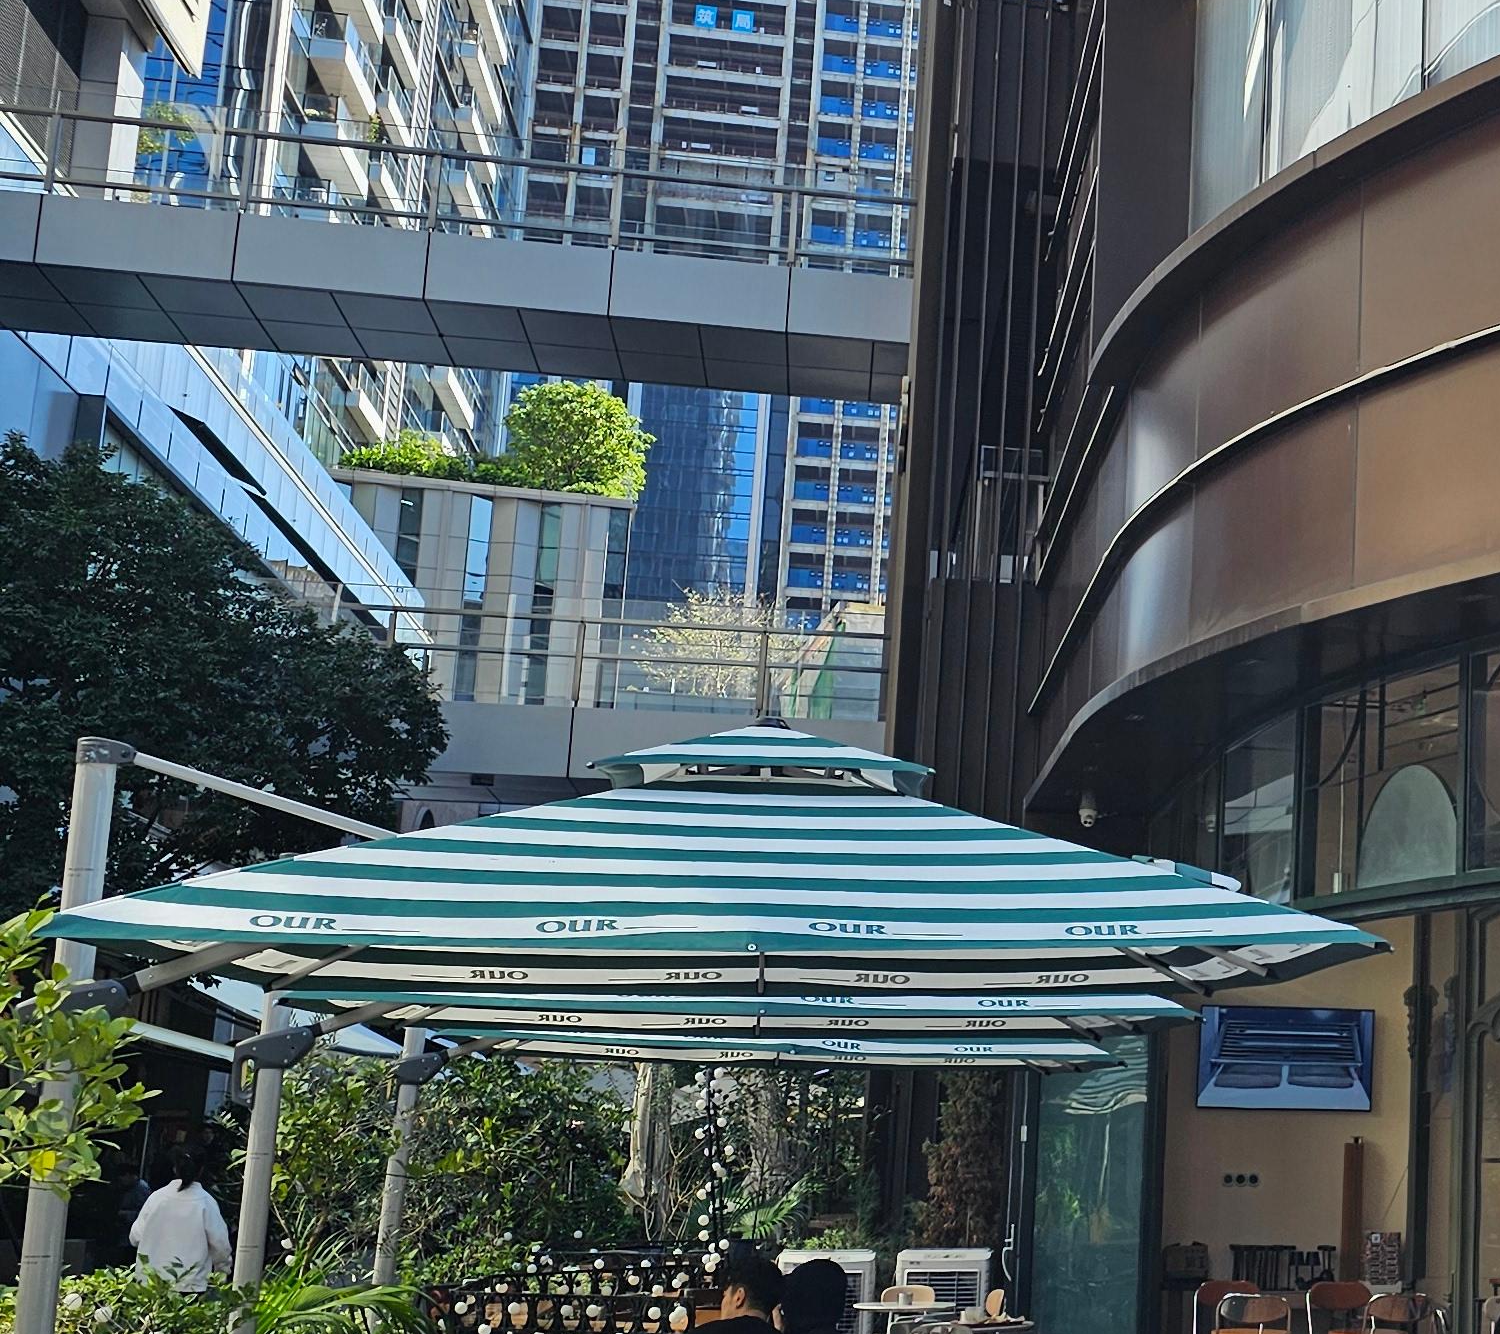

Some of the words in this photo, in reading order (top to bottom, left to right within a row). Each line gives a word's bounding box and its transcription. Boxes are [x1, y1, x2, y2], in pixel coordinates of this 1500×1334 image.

[249, 913, 337, 932] OUR
[535, 917, 619, 934] OUR
[808, 921, 888, 937] OUR
[1064, 923, 1141, 937] OUR
[977, 998, 1029, 1008] OUR
[822, 1039, 861, 1051] OUR
